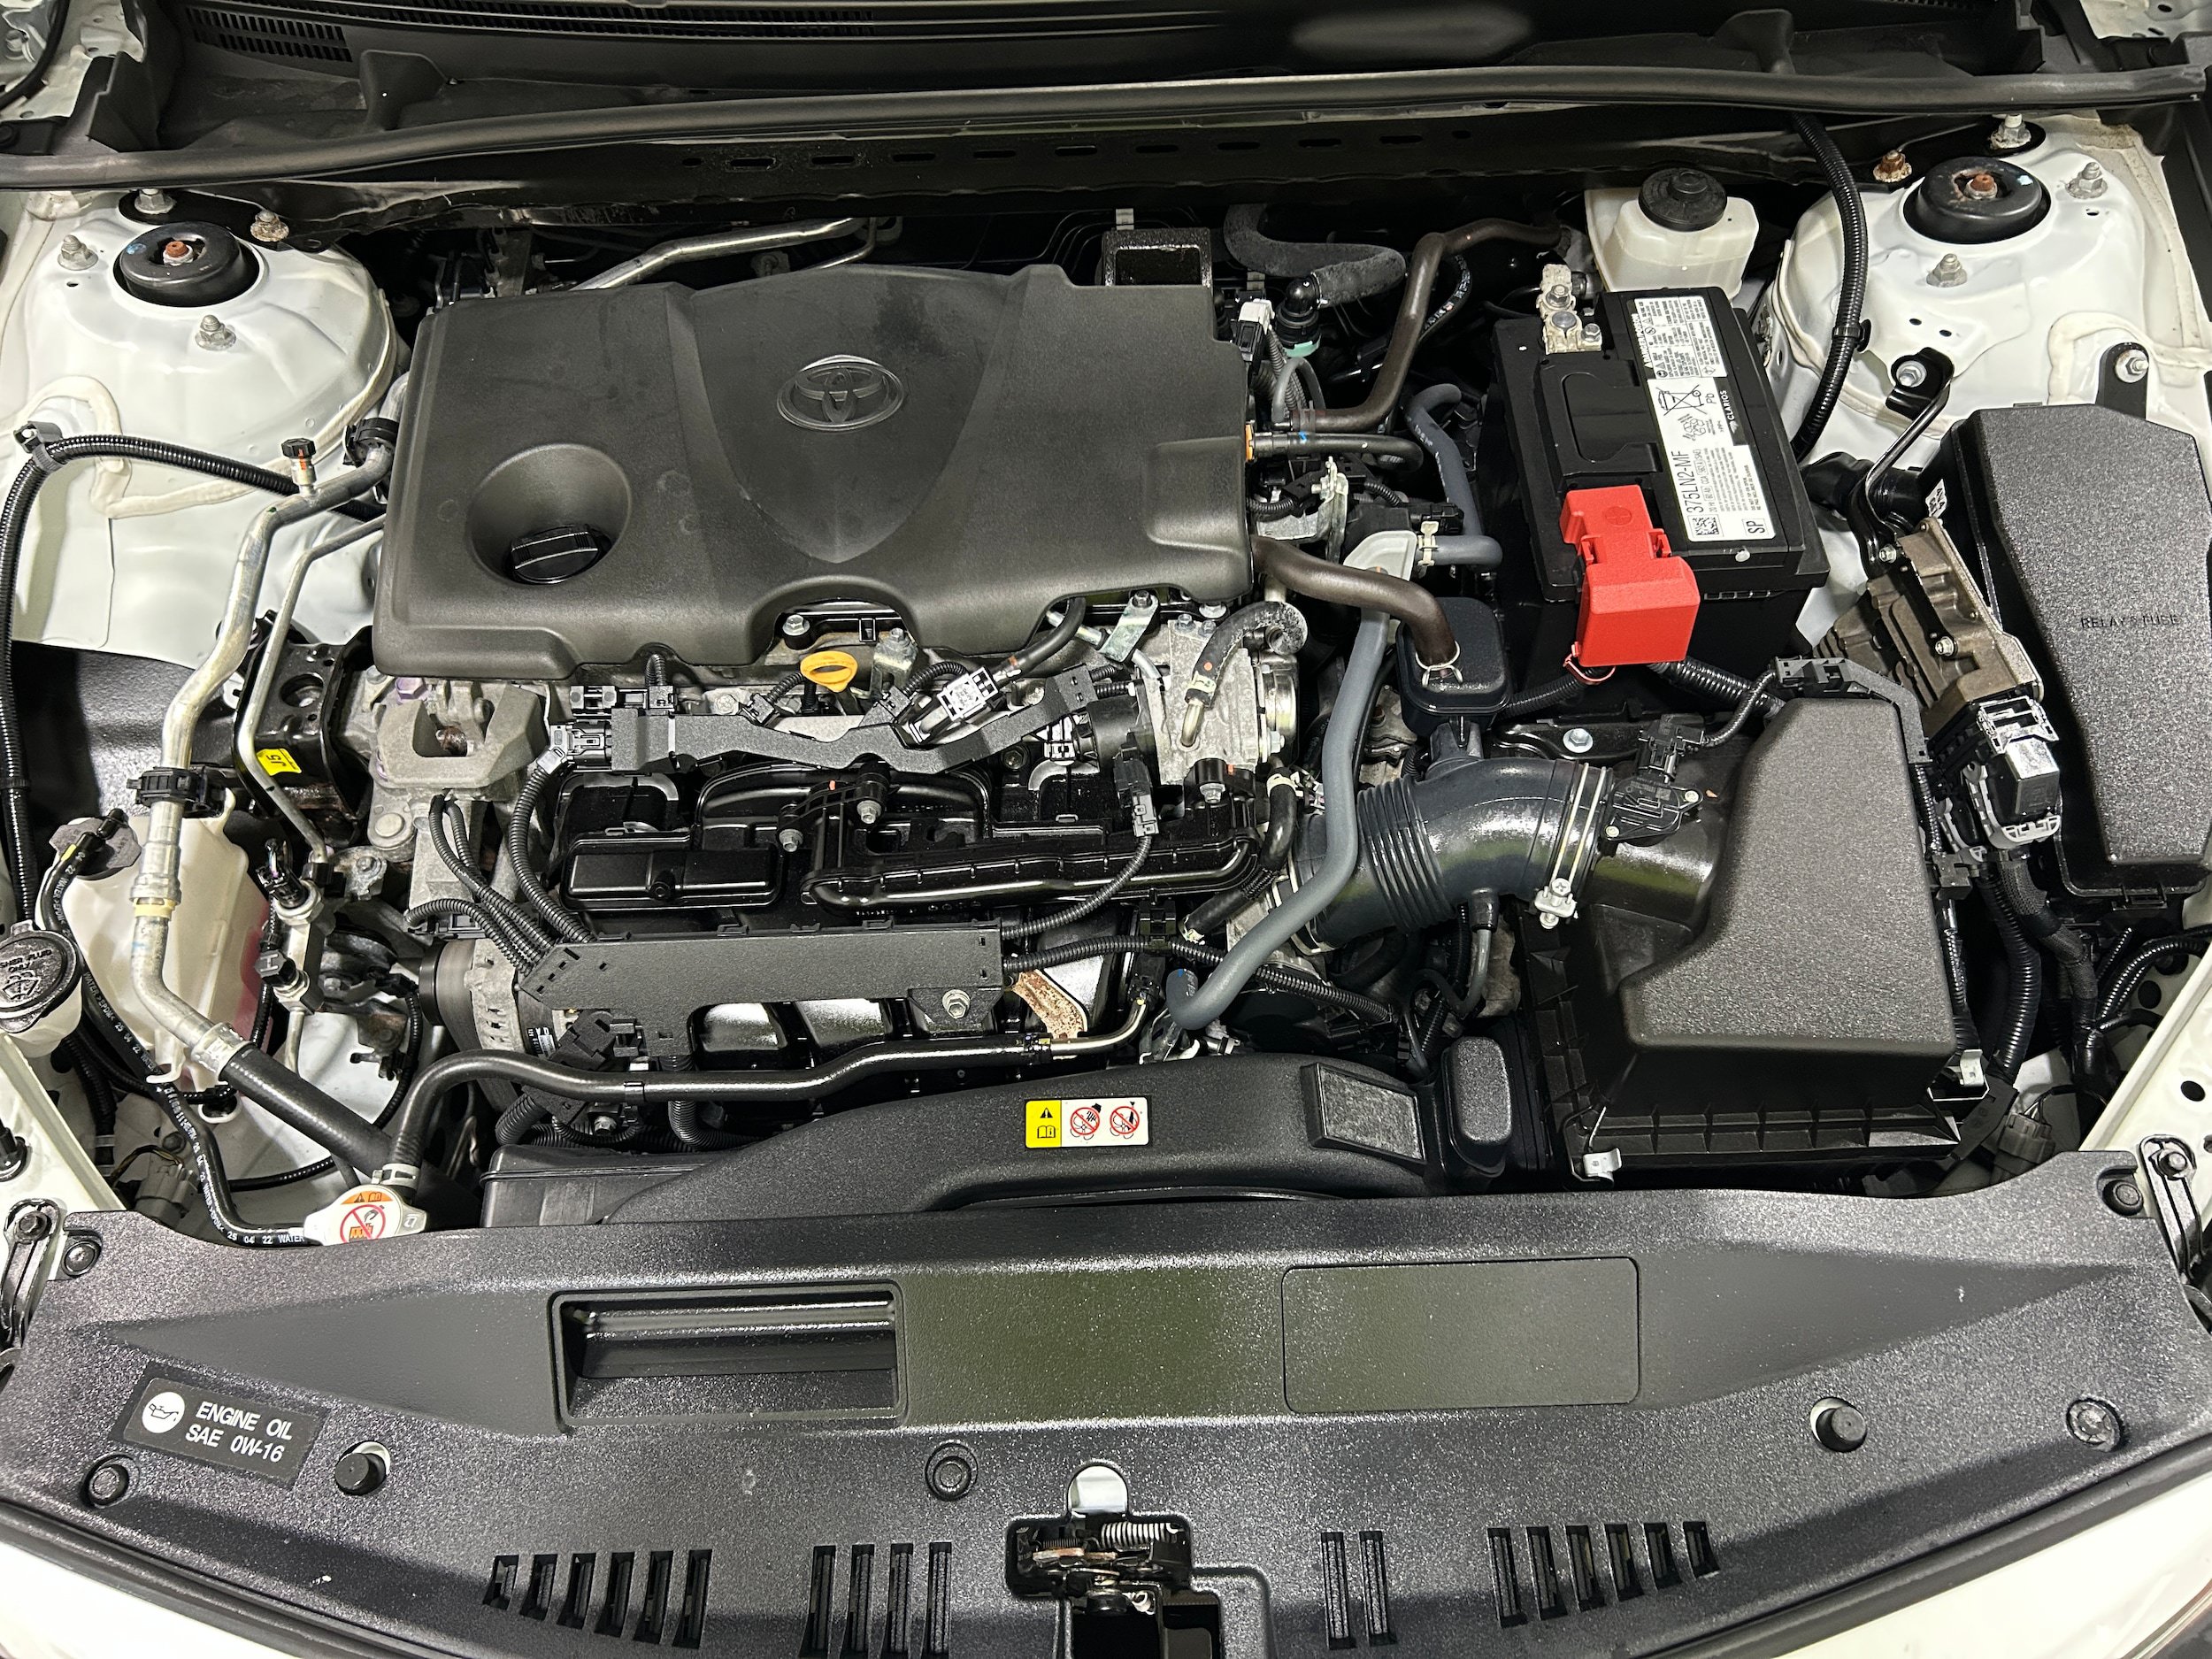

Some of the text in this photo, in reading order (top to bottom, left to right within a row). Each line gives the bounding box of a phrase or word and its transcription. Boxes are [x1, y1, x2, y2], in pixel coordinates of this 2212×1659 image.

[1705, 393, 1717, 403] Pb
[1719, 389, 1735, 420] CLARIOS
[1671, 450, 1703, 513] 375LN2-MF
[1746, 520, 1765, 534] SP
[2081, 613, 2178, 628] RELAY FUSE
[65, 864, 75, 875] 22
[27, 949, 52, 961] FLUID
[9, 961, 33, 972] ONLY
[114, 1022, 124, 1032] 25
[227, 1231, 237, 1240] 25
[244, 1235, 255, 1244] 04
[262, 1235, 273, 1244] 22
[278, 1234, 305, 1243] WATER
[196, 1401, 293, 1440] ENGINE OIL
[185, 1424, 285, 1463] SAE 0W-16
